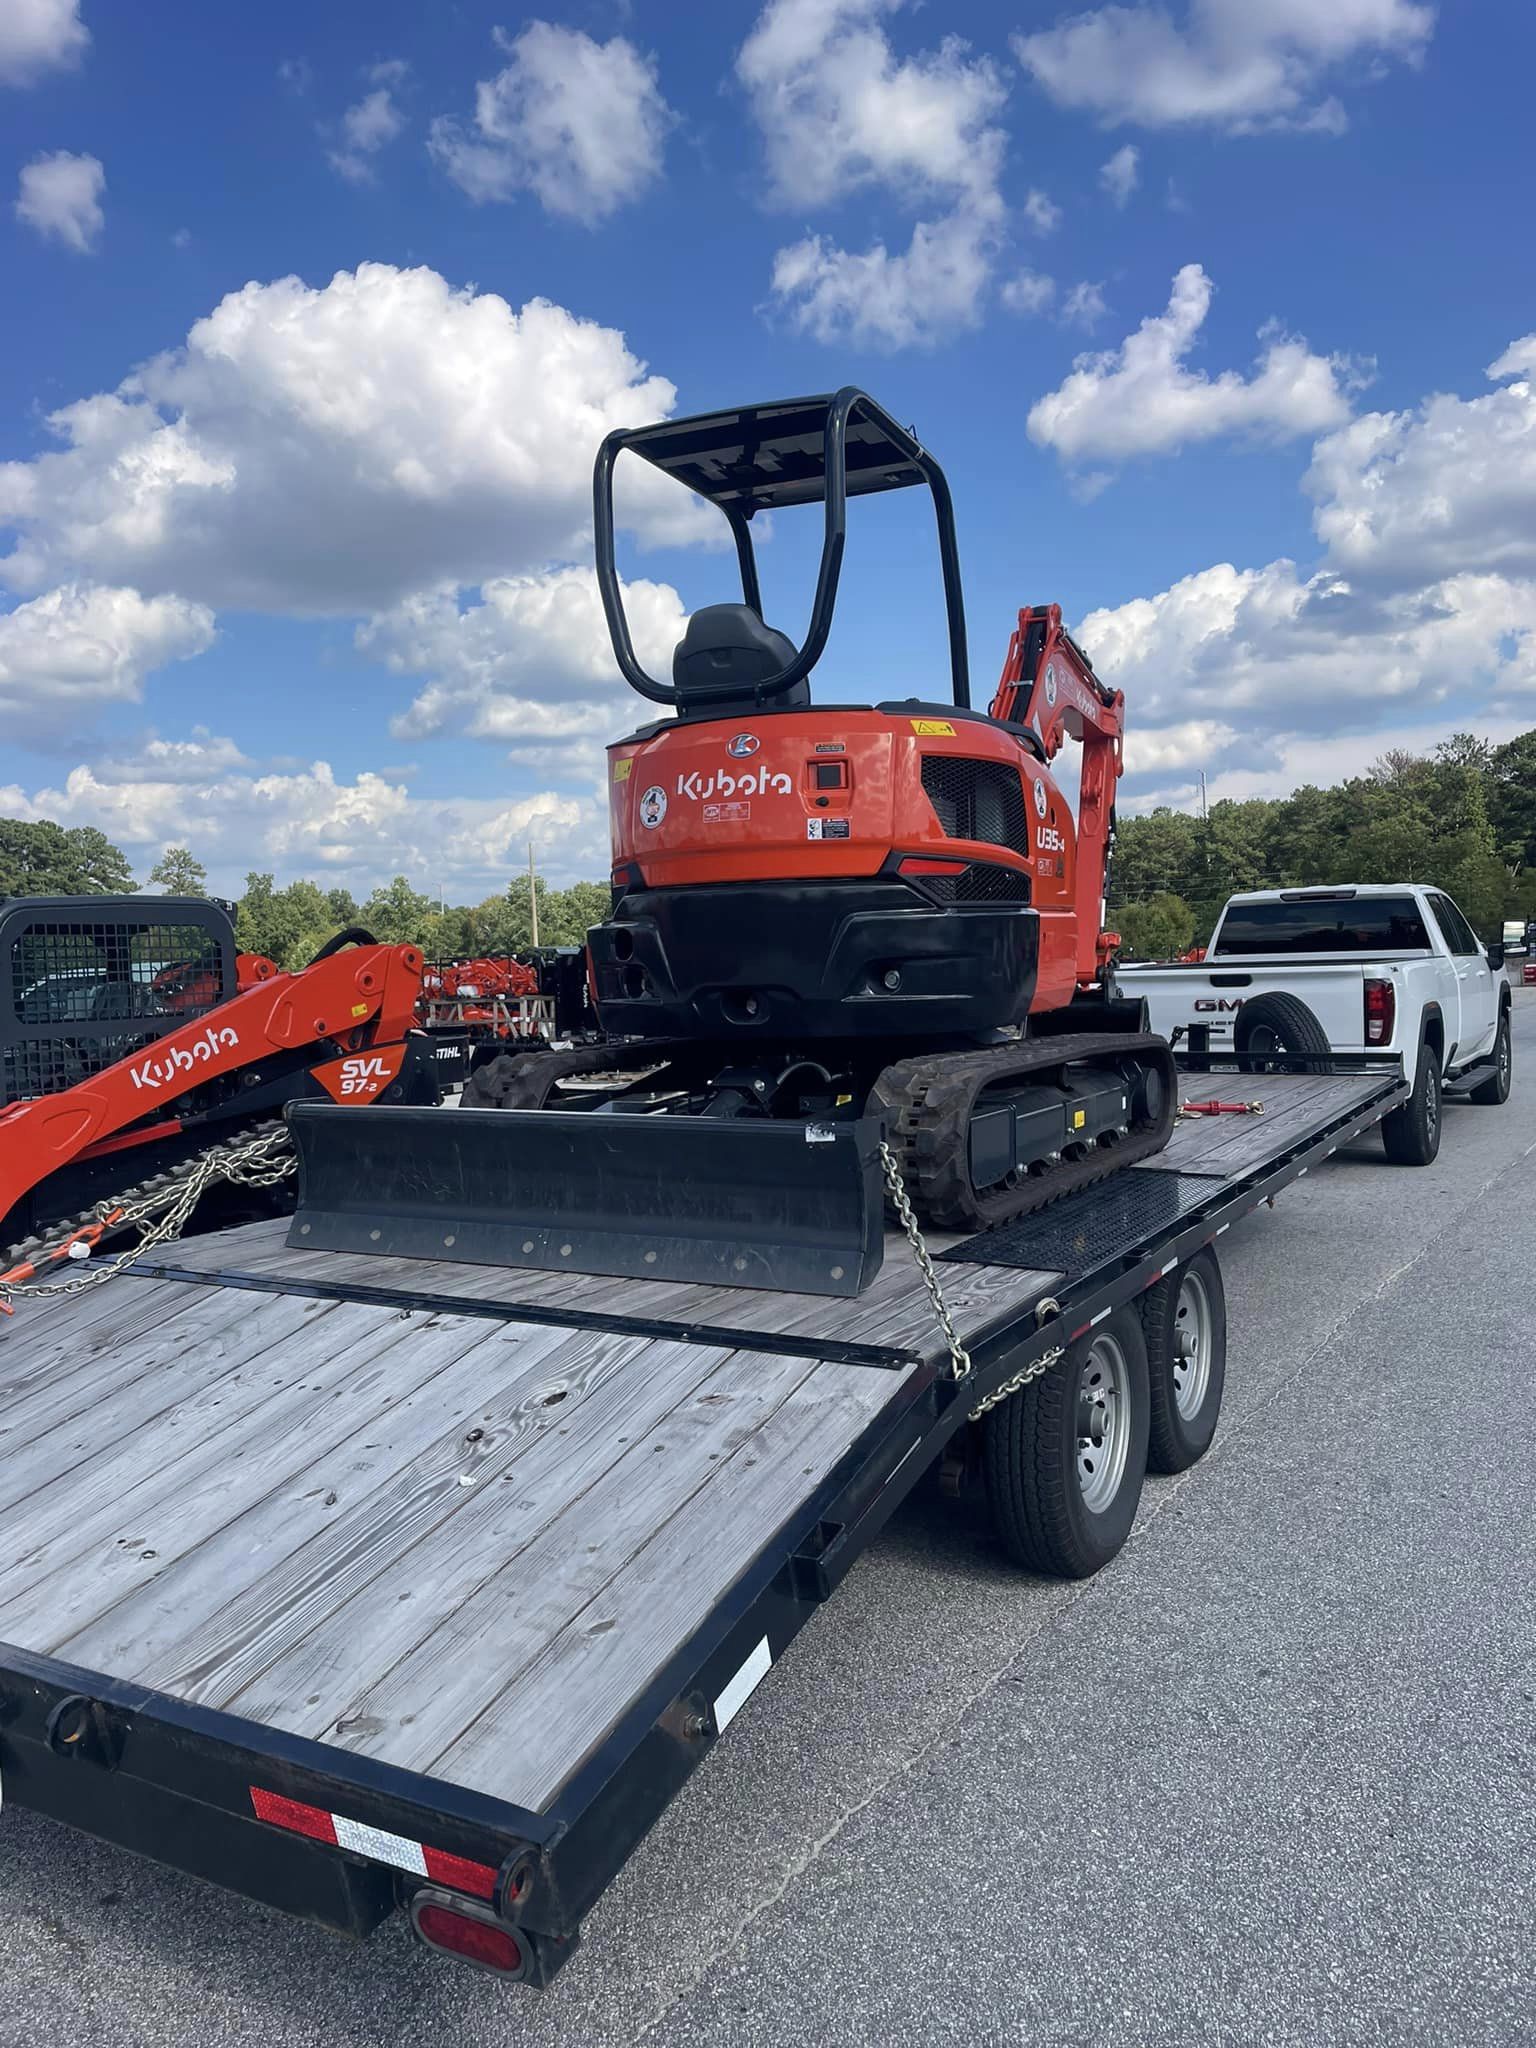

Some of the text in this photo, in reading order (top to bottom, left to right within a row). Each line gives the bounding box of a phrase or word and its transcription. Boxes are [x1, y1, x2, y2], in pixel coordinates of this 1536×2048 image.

[677, 765, 793, 801] Kubota
[1037, 825, 1065, 853] U35-4
[1194, 998, 1248, 1013] GM
[129, 1027, 240, 1089] Kubota
[339, 1057, 392, 1079] SVL
[340, 1078, 378, 1096] 97-2
